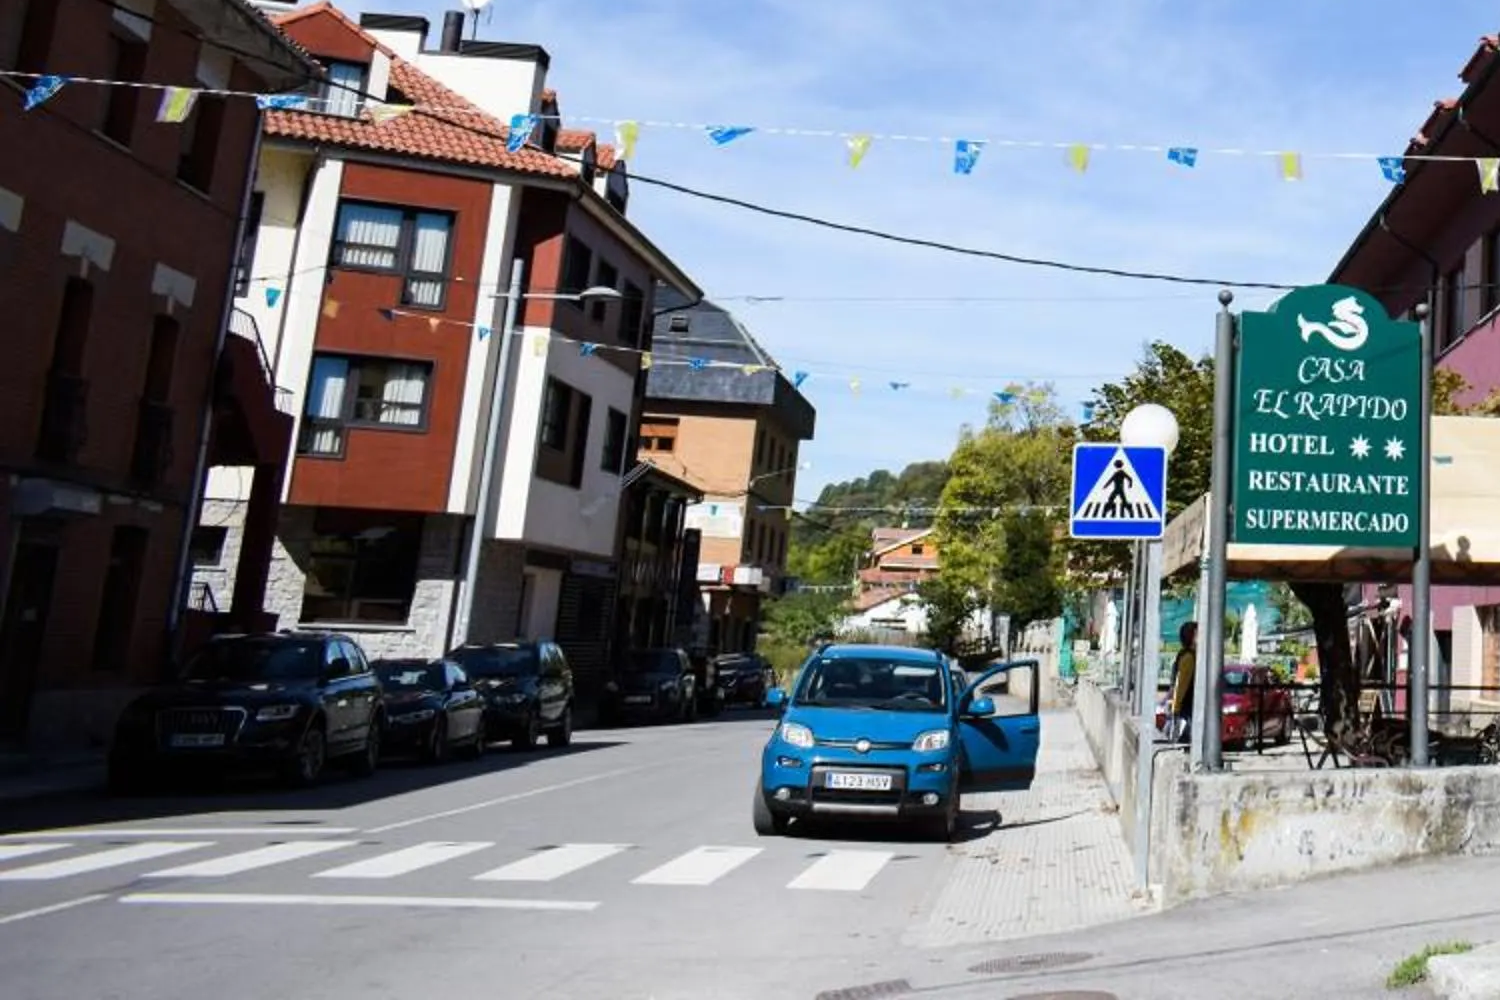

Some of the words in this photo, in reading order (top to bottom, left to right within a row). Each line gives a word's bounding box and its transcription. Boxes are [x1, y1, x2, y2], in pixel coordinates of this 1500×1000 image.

[1298, 356, 1366, 384] CASA
[1253, 388, 1290, 419] EL
[1294, 391, 1408, 421] RAPIDO
[1250, 432, 1335, 455] HOTEL
[1248, 469, 1409, 495] RESTAURANTE
[1246, 508, 1409, 533] SUPERMERCADO
